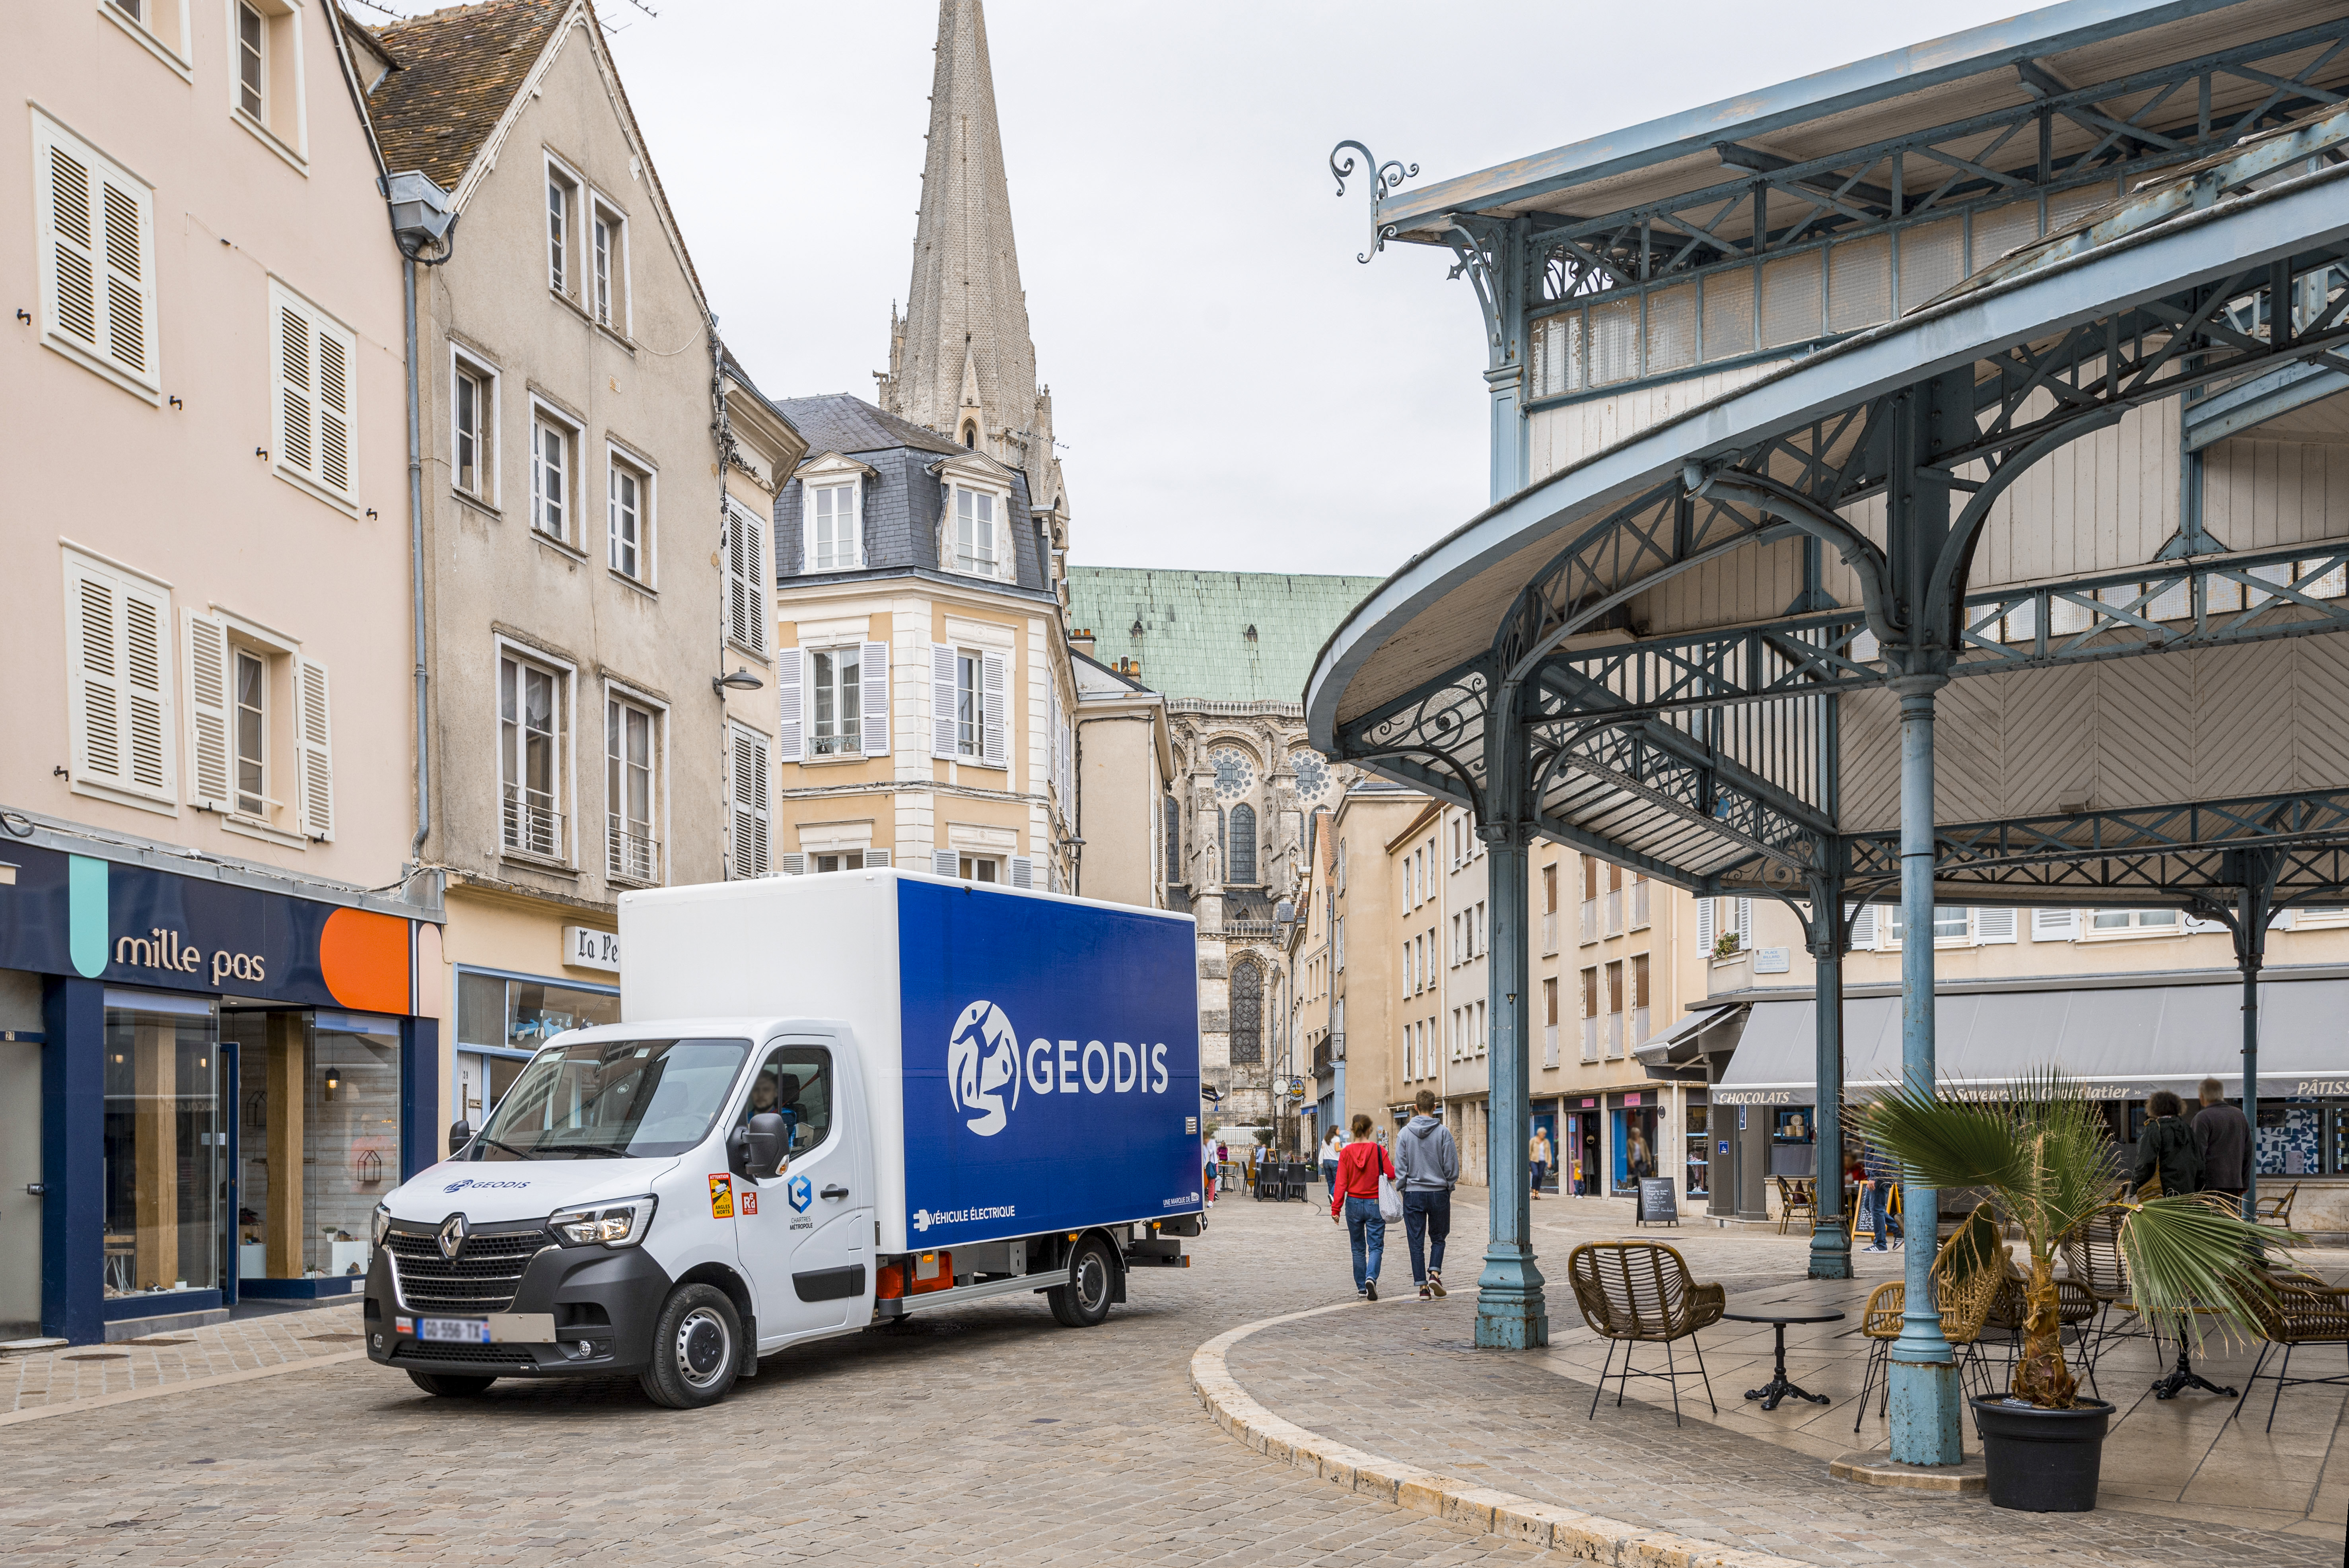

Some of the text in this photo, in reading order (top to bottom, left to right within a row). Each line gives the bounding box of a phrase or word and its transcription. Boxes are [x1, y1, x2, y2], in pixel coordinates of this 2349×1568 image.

[578, 930, 595, 959] La
[118, 928, 265, 986] mille pas
[1026, 1038, 1169, 1095] GEODIS
[1719, 1092, 1790, 1104] CHOCOLATS
[1954, 1088, 2013, 1101] Saveurs
[929, 1205, 1015, 1225] VÉHICULE ÉLECTRIQUE
